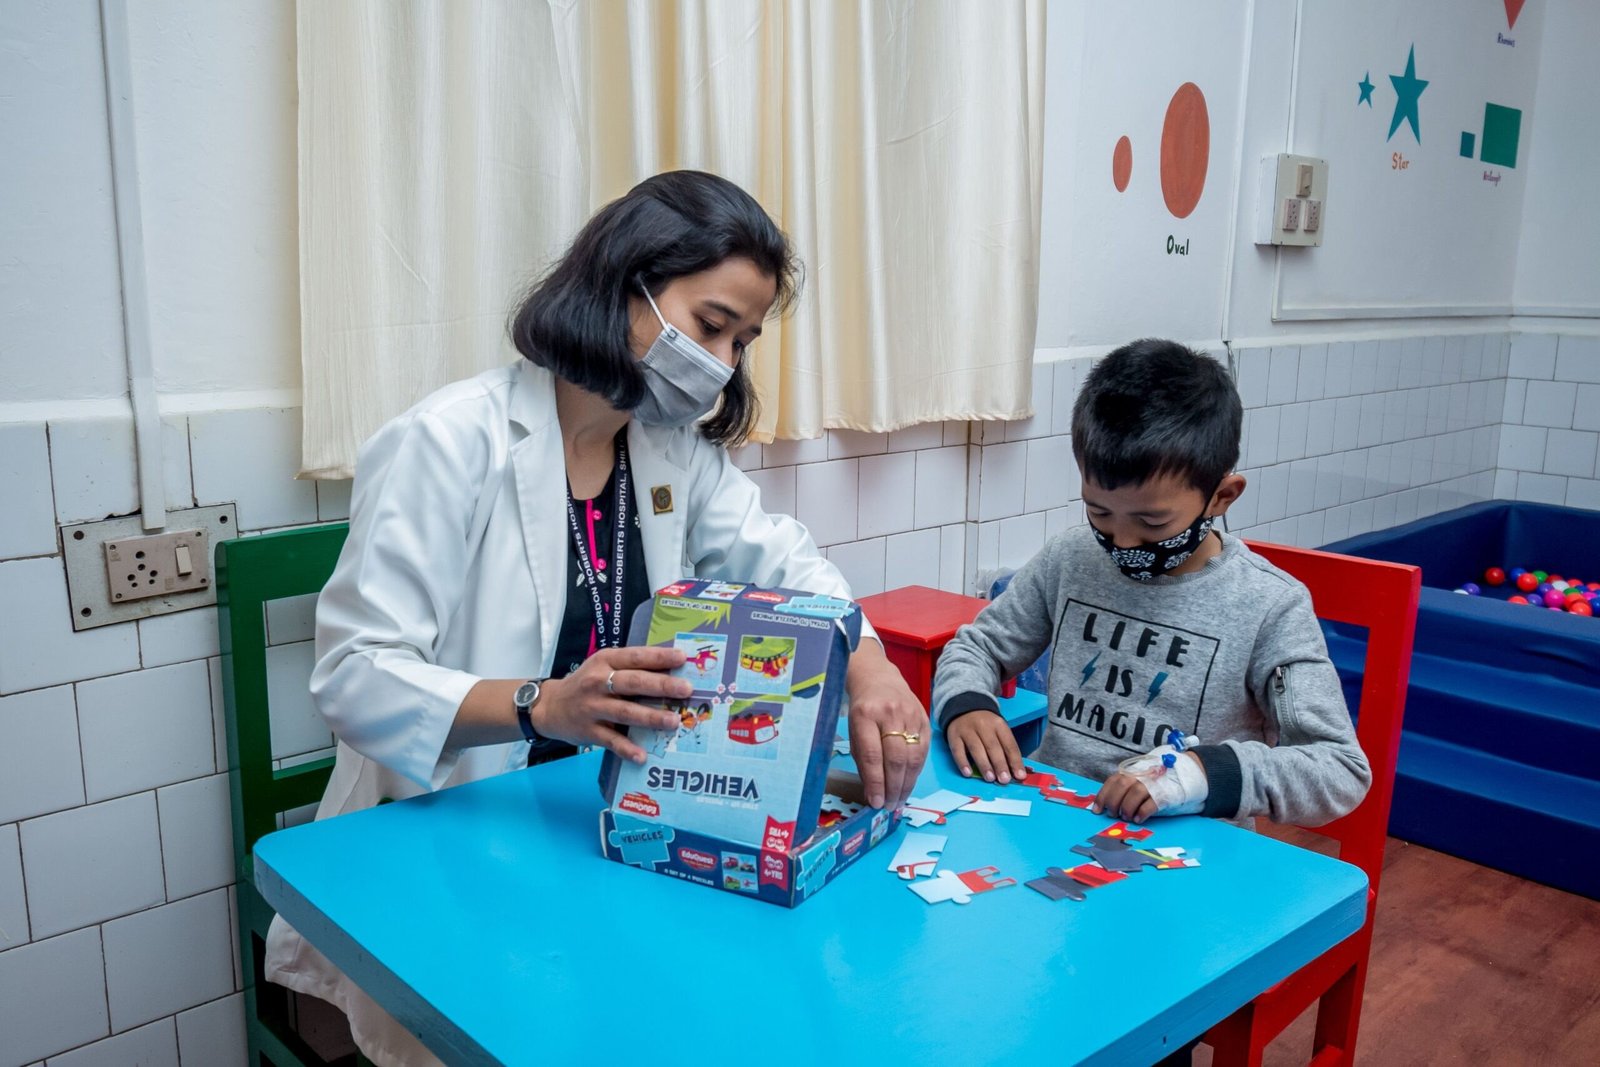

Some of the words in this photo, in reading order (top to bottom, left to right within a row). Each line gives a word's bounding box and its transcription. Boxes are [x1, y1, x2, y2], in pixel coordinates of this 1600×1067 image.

[1391, 152, 1410, 171] Star
[1166, 234, 1190, 257] Oval
[575, 532, 595, 585] ROBERTS
[616, 530, 625, 584] ROBERTS
[590, 586, 605, 634] GORDON
[613, 586, 623, 635] GORDON
[810, 620, 830, 629] TOTAL
[1083, 613, 1190, 668] LIFE
[1104, 664, 1134, 697] IS
[648, 766, 760, 800] VEHICLES
[623, 799, 657, 815] EduQuest
[621, 830, 664, 843] VEHICLES
[681, 849, 714, 865] EduQuest
